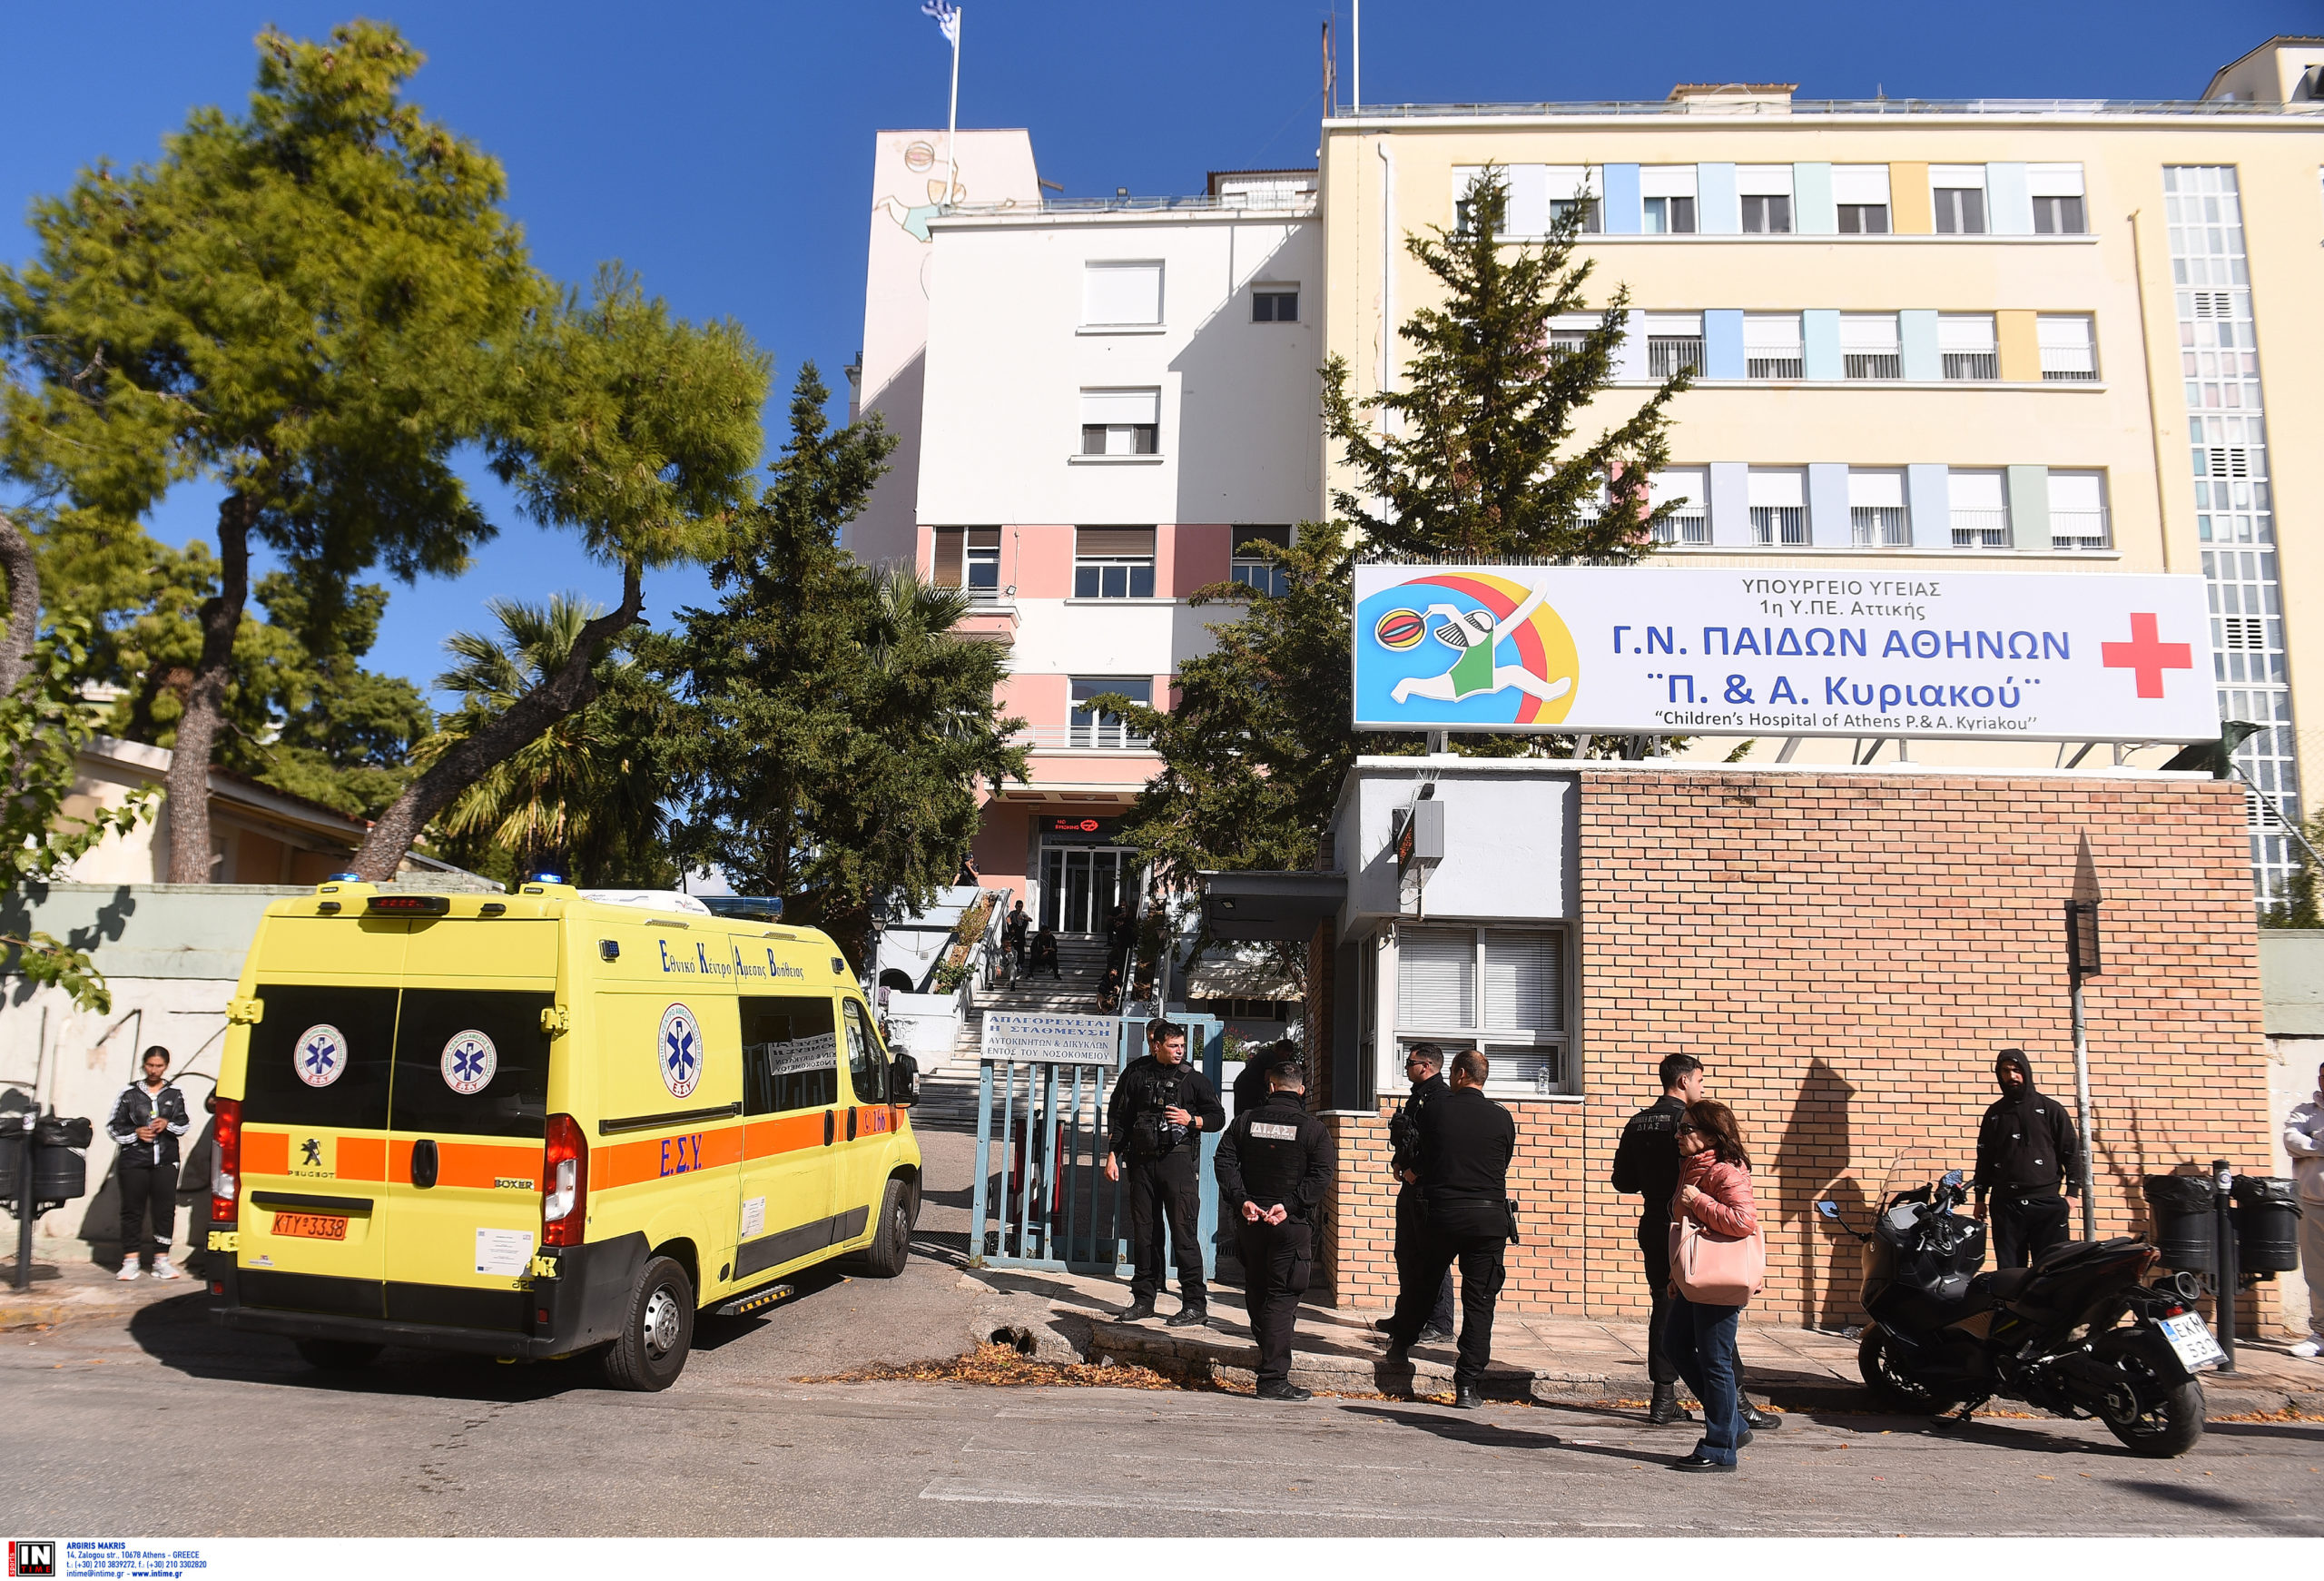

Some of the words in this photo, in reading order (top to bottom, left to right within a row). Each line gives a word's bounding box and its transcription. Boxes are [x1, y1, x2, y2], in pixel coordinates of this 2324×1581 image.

[1742, 579, 1863, 595] ΥΠΟΥΡΓΕΙΟ
[1869, 581, 1941, 597] ΥΓΕΙΑΣ
[1760, 599, 1783, 618] 1η
[1789, 600, 1844, 616] Υ.ΠΕ.
[1851, 601, 1925, 620] Αττικής
[1613, 626, 1687, 654] Γ.Ν.
[1703, 627, 1866, 657] ΠΑΙΔΩΝ
[1882, 629, 2070, 659] ΑΘΗΝΩΝ
[1723, 674, 1756, 705] &
[1768, 676, 1809, 705] Α.
[1749, 712, 1817, 728] Hospital
[1822, 713, 1839, 726] of
[1844, 714, 1901, 728] Athens
[659, 939, 695, 973] Εθνικό
[696, 942, 732, 978] Κέντρο
[766, 948, 804, 981] Βοήθειας
[990, 1016, 1110, 1028] ΑΠΑΓΟΡΕΥΕΤΑΙ
[1009, 1026, 1110, 1037] ΣΤΑΘΜΕΥΣΗ
[989, 1037, 1052, 1047] ΑΥΤΟΚΙΝΗΤΩΝ
[1062, 1040, 1108, 1050] ΔΙΚΥΚΛΩΝ
[987, 1047, 1016, 1056] ΕΝΤΟΣ
[1020, 1049, 1039, 1057] ΤΟΥ
[1043, 1050, 1109, 1061] ΝΟΣΟΚΟΜΕΙΟΥ
[873, 1108, 886, 1132] 166
[660, 1133, 703, 1177] Ε.Σ.Υ.
[288, 1170, 335, 1179] PEUGEOT
[495, 1180, 534, 1190] BOXER
